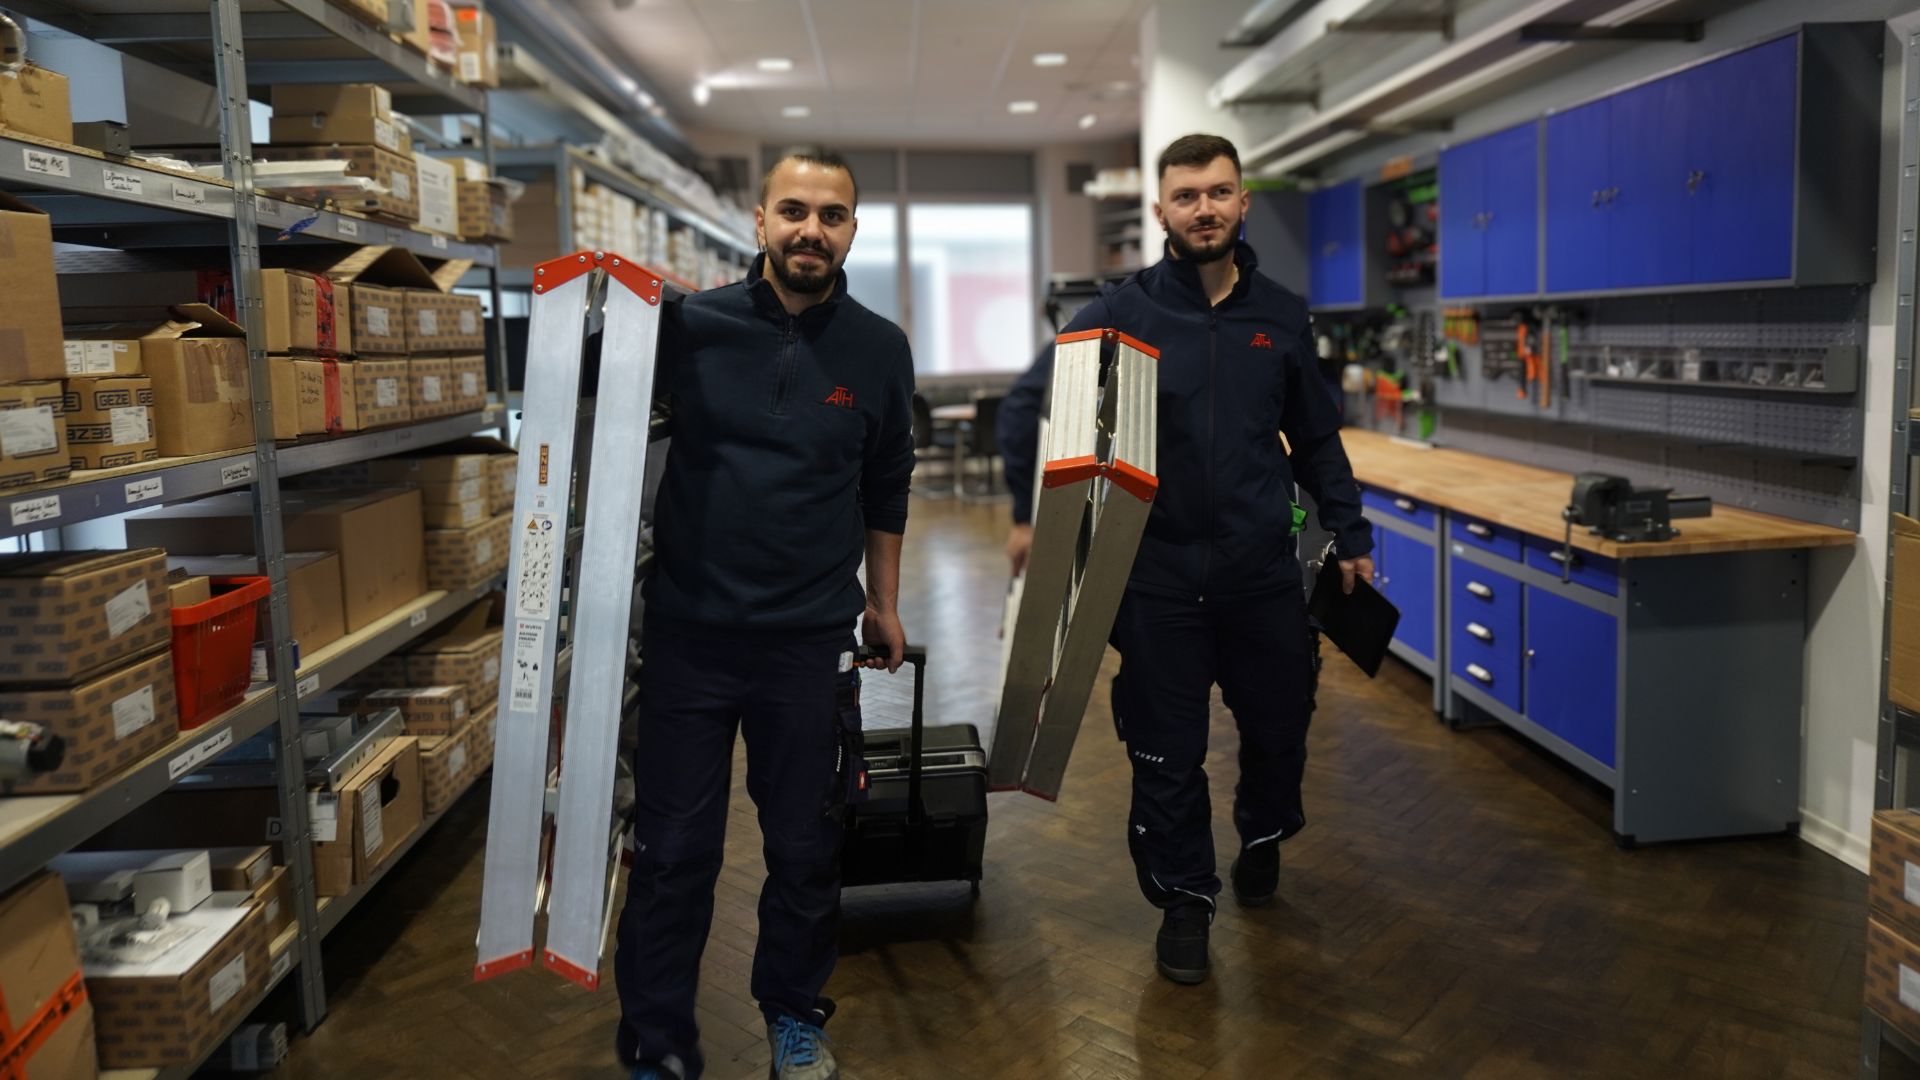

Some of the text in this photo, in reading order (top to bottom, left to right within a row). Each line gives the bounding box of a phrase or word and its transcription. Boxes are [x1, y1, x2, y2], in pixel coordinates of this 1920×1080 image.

[99, 393, 129, 407] GEZE
[824, 386, 853, 408] ATH
[539, 446, 548, 484] GEZE
